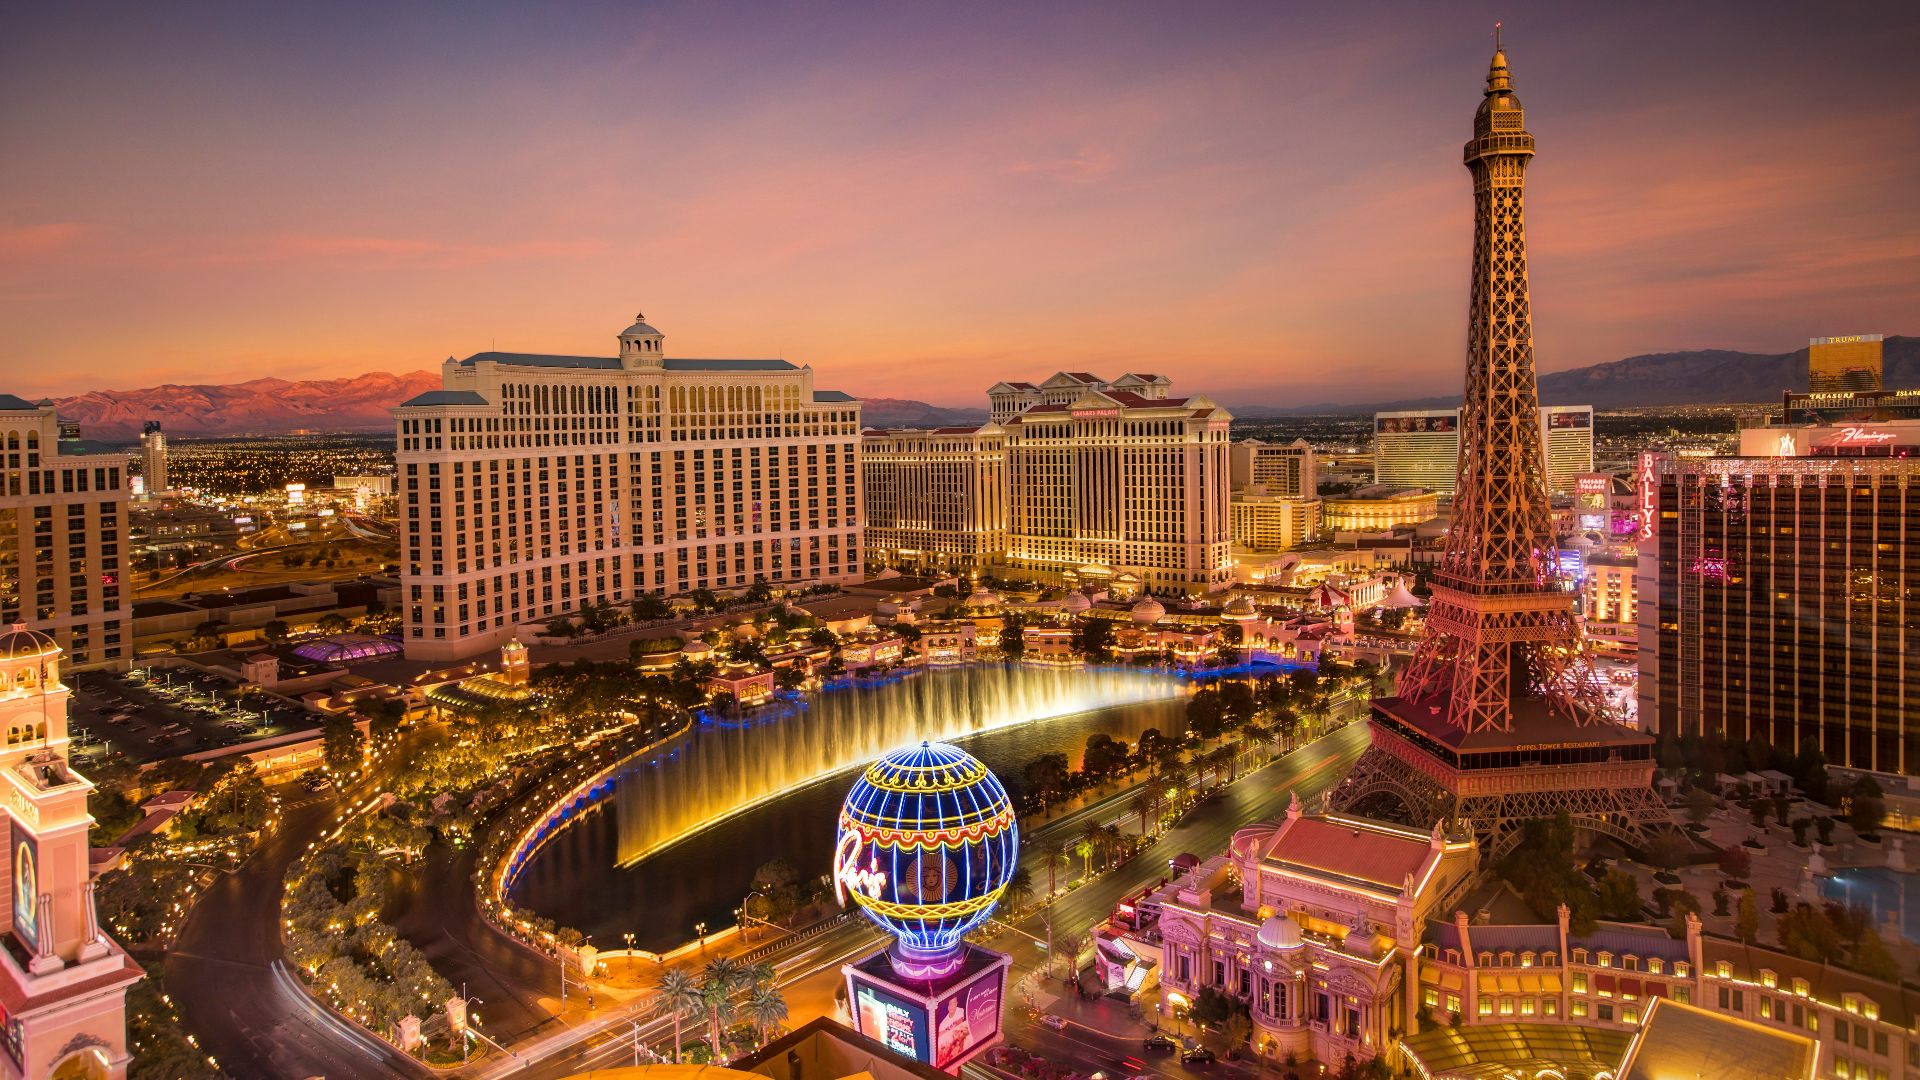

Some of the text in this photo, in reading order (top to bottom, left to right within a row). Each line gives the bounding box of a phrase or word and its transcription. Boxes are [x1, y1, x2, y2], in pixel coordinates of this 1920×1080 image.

[1810, 392, 1855, 400] TREASURE
[1841, 427, 1896, 443] Flamingo
[1516, 744, 1537, 752] EIFFEL
[1563, 741, 1600, 749] RESTAURANT
[834, 829, 887, 908] Paris
[886, 1003, 910, 1018] DAILY
